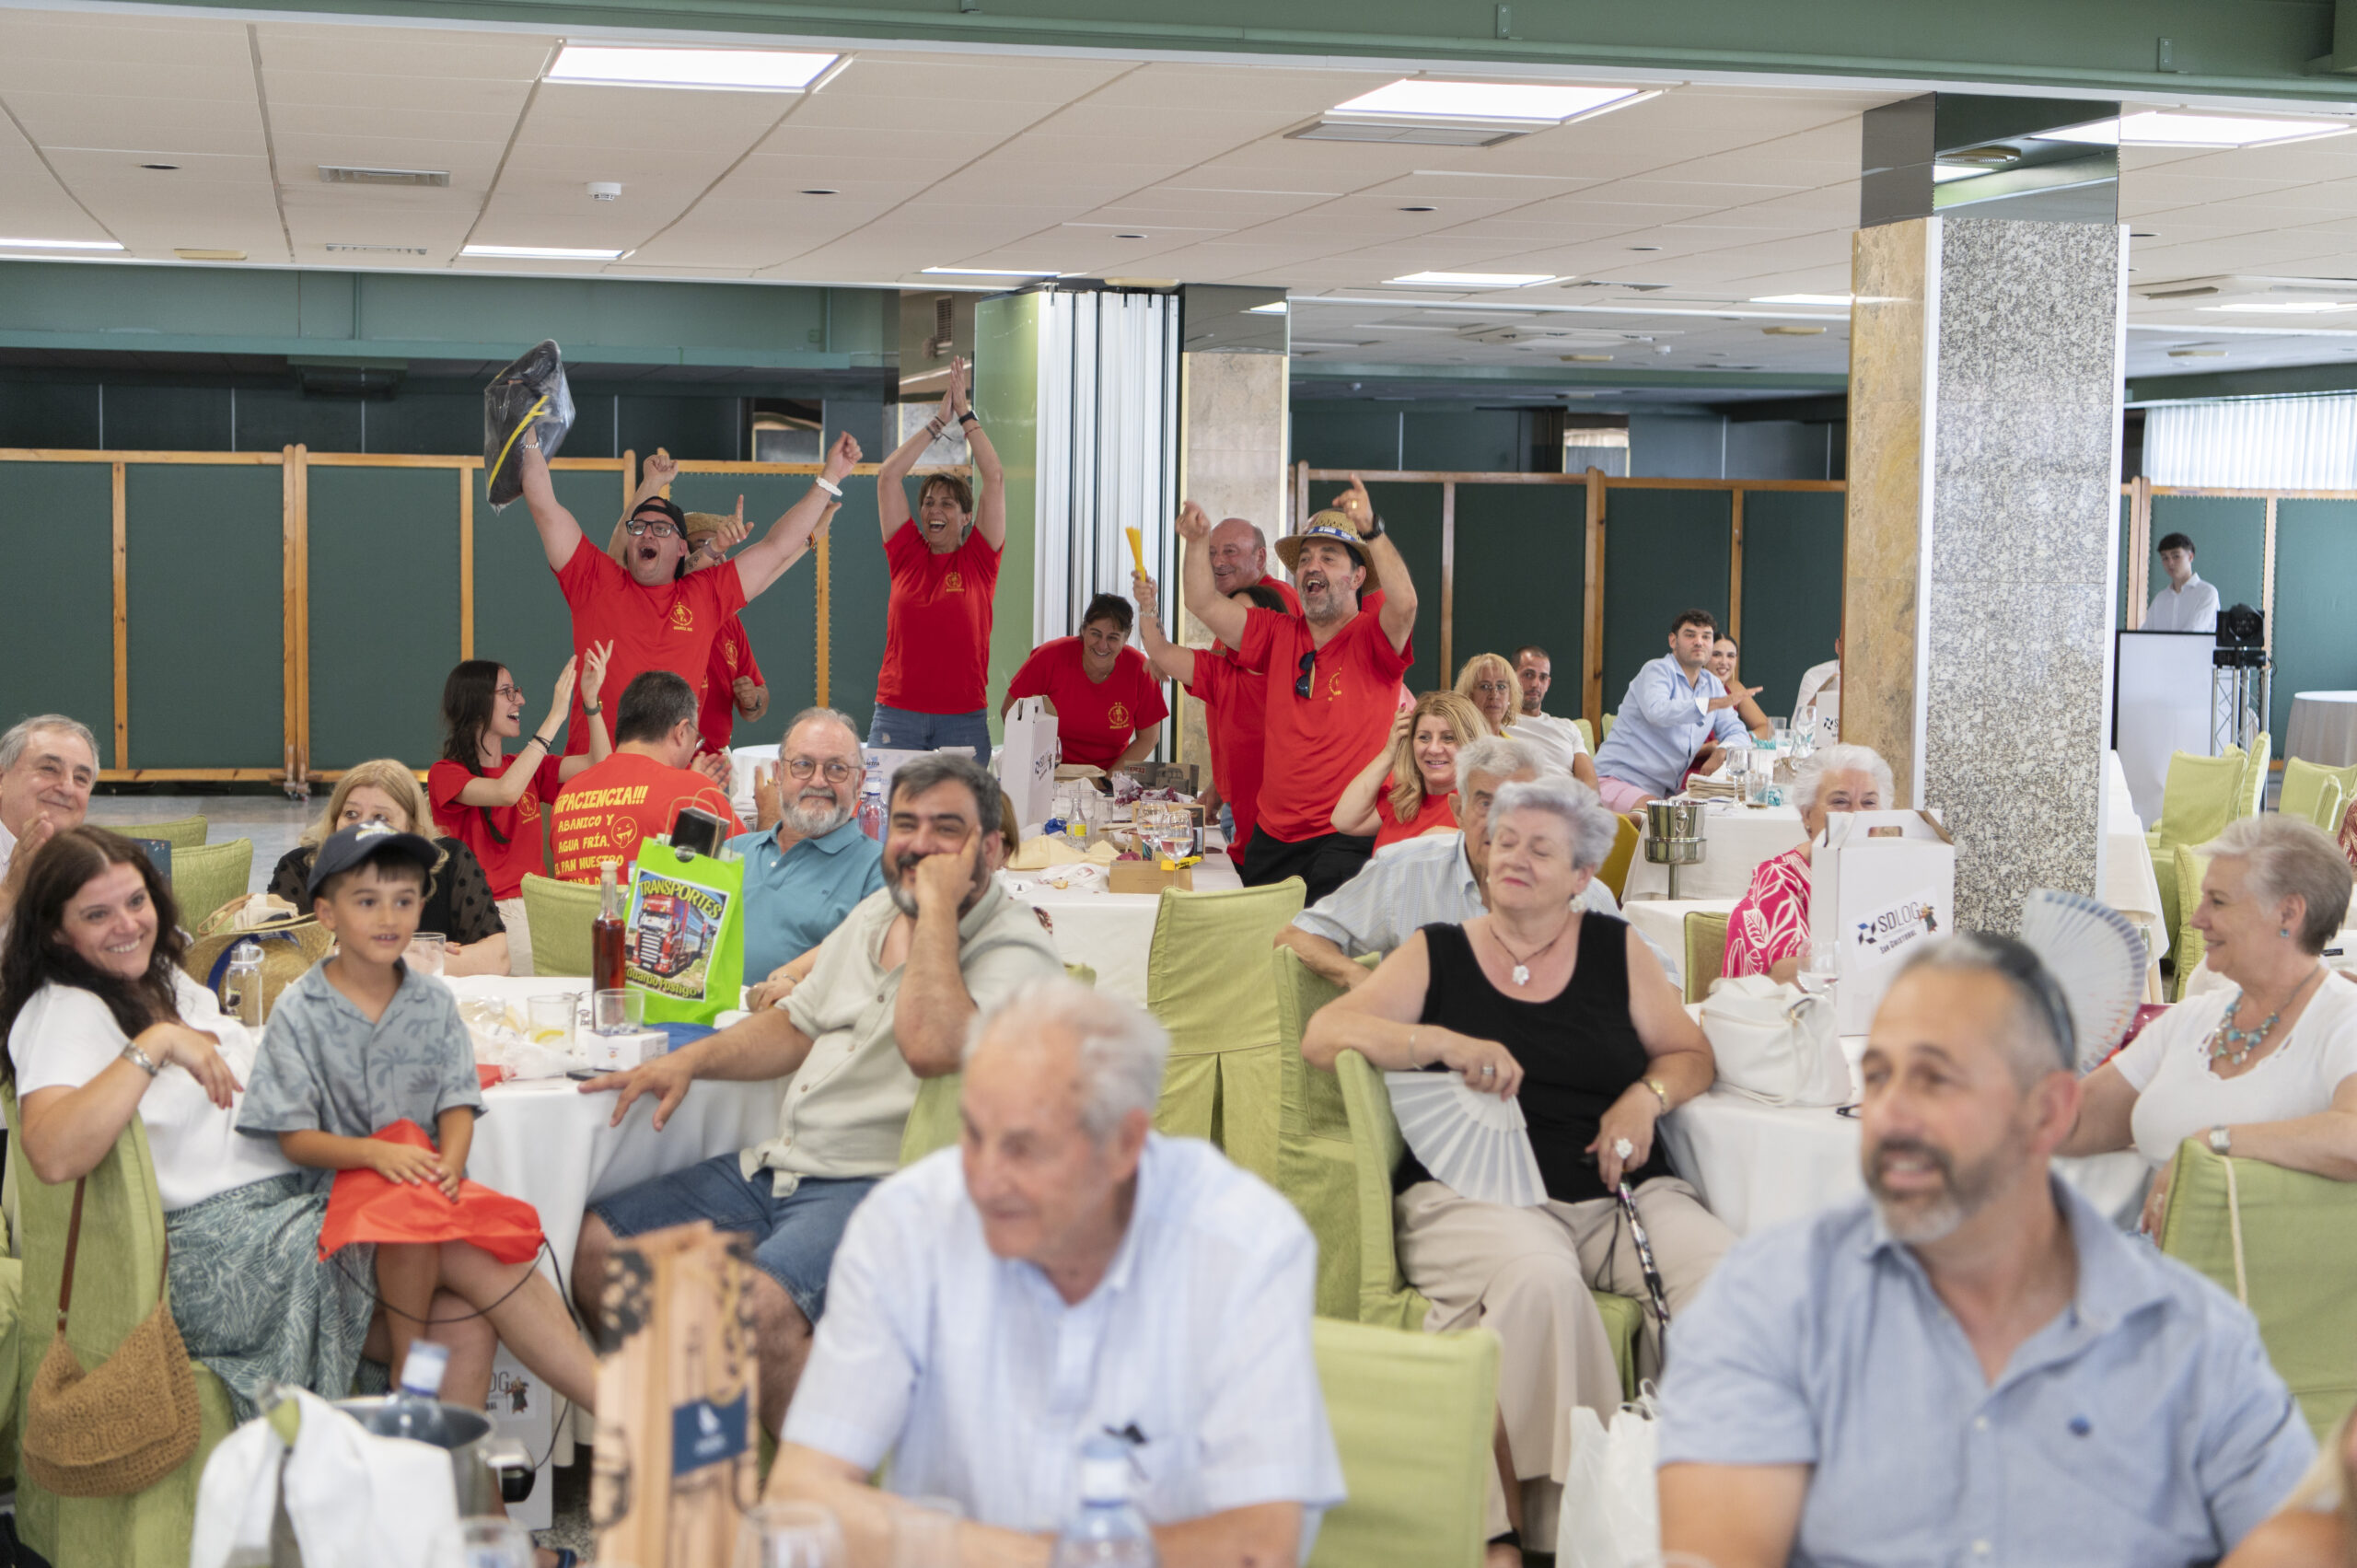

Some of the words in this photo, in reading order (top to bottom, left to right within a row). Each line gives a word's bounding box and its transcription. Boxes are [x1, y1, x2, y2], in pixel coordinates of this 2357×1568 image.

[557, 815, 602, 833] ABANICO
[606, 813, 615, 826] Y
[558, 838, 579, 854] AGUA
[582, 832, 610, 849] FRÍA.
[561, 858, 577, 874] PAN
[638, 877, 723, 920] TRANSPORTES
[1877, 900, 1921, 933] SDLOG
[625, 967, 658, 987] duardo
[658, 977, 697, 997] Postigo
